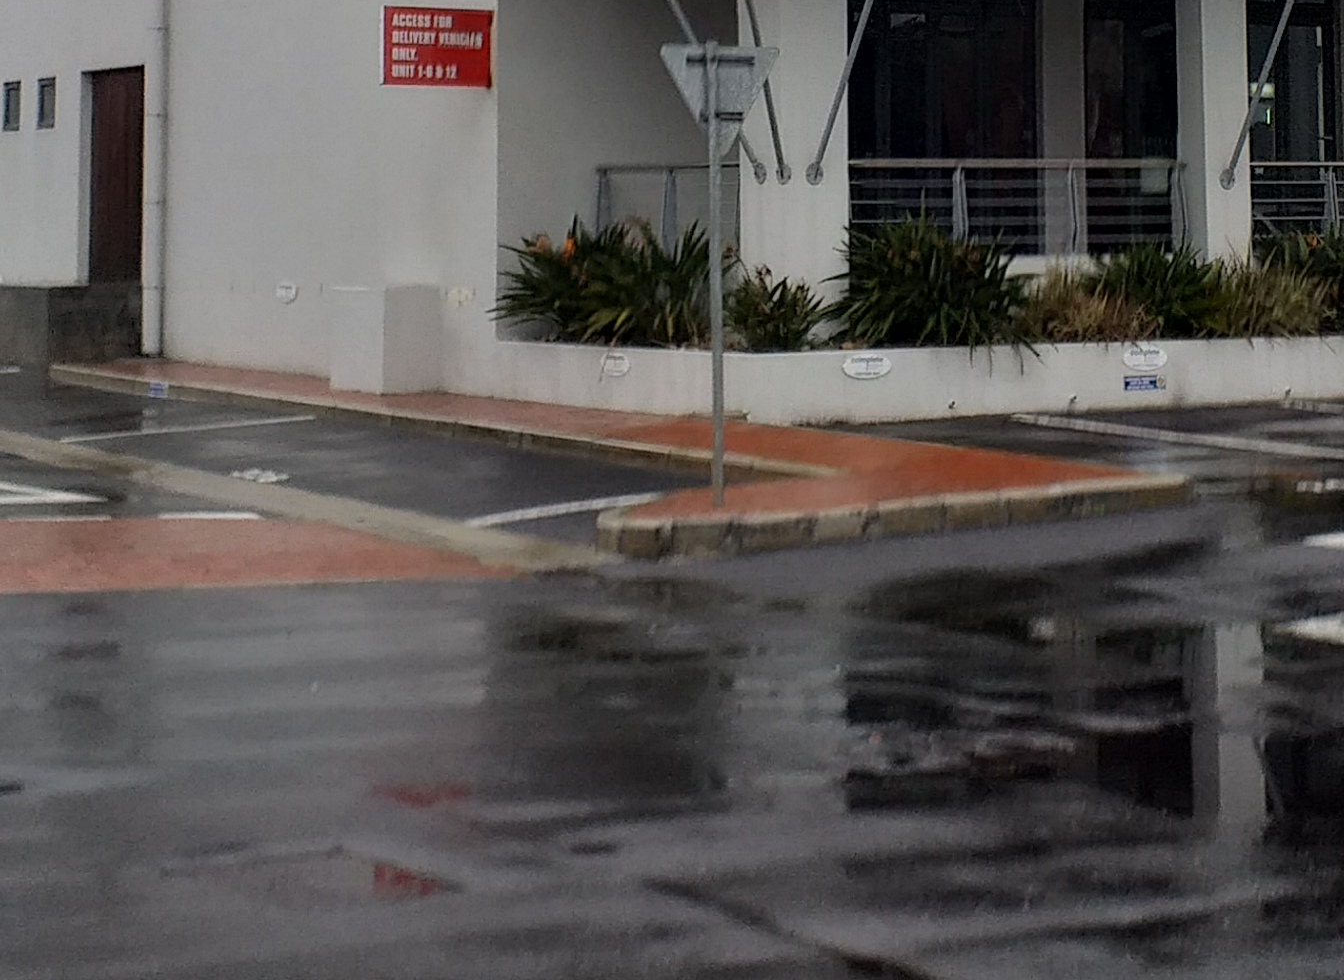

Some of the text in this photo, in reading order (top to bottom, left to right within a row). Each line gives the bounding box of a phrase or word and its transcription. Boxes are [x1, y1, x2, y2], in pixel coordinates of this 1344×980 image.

[392, 14, 453, 28] ACCESS FOR
[392, 31, 436, 45] DELIVERY
[392, 64, 415, 78] UNIT
[445, 65, 458, 79] 12
